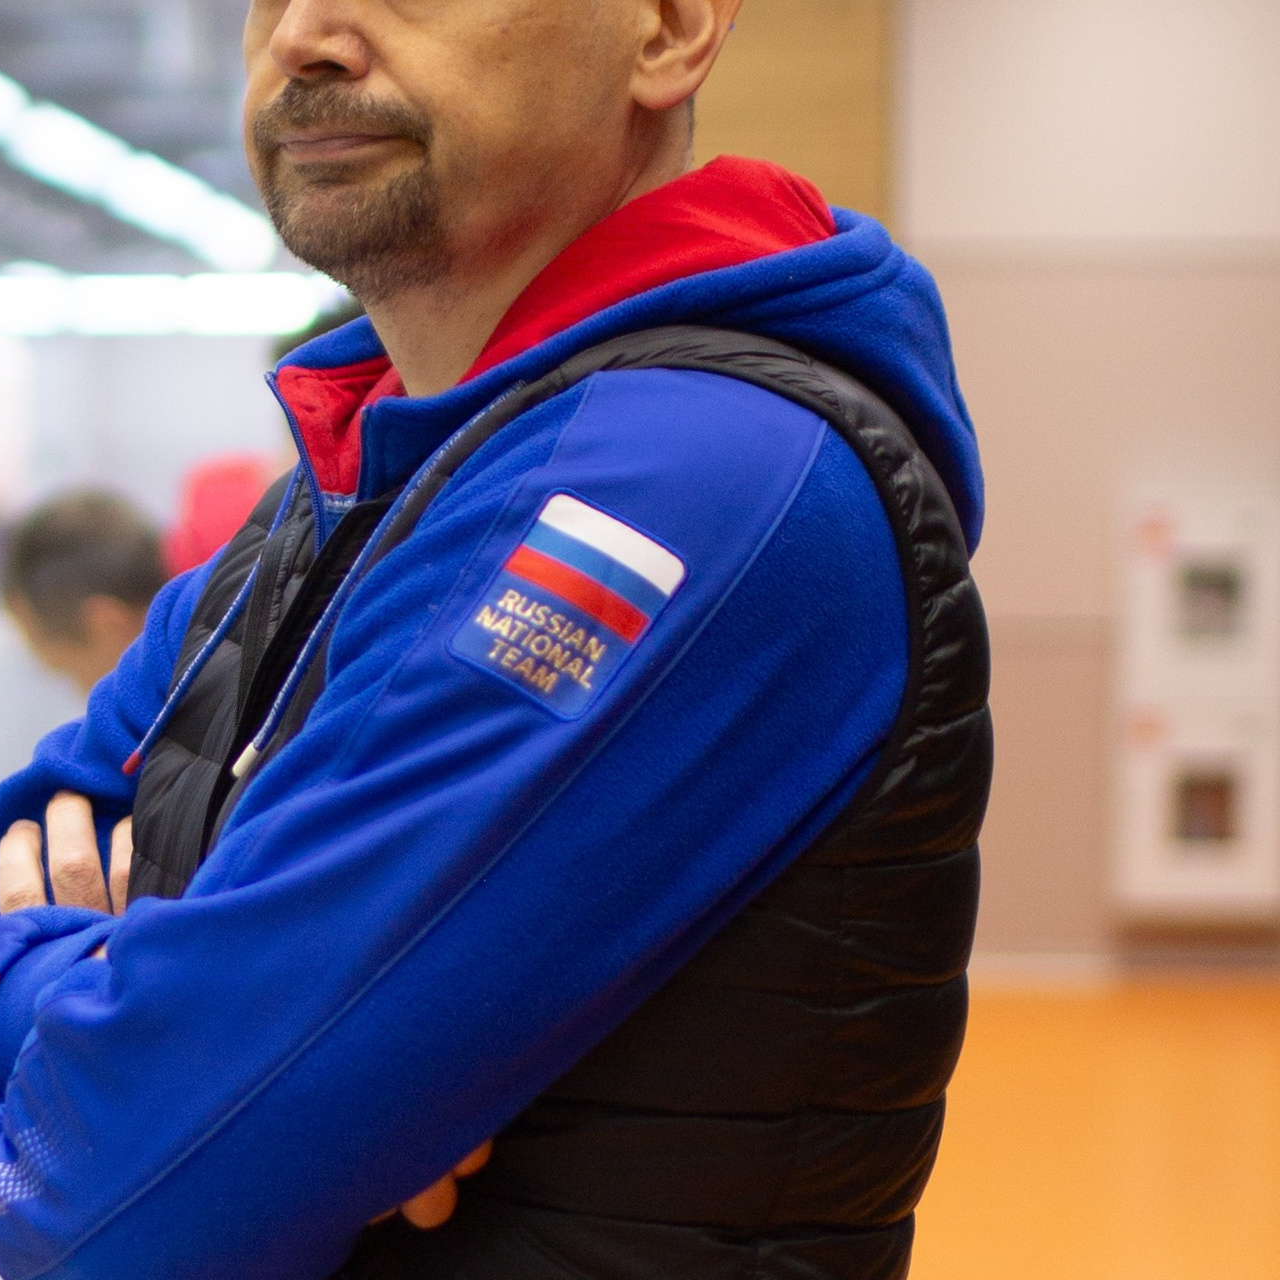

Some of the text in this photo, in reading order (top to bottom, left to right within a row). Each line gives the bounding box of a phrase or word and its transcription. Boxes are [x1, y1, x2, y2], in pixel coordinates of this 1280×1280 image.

[475, 604, 594, 690] NATIONAL
[497, 588, 607, 662] RUSSIAN
[487, 638, 560, 694] TEAM
